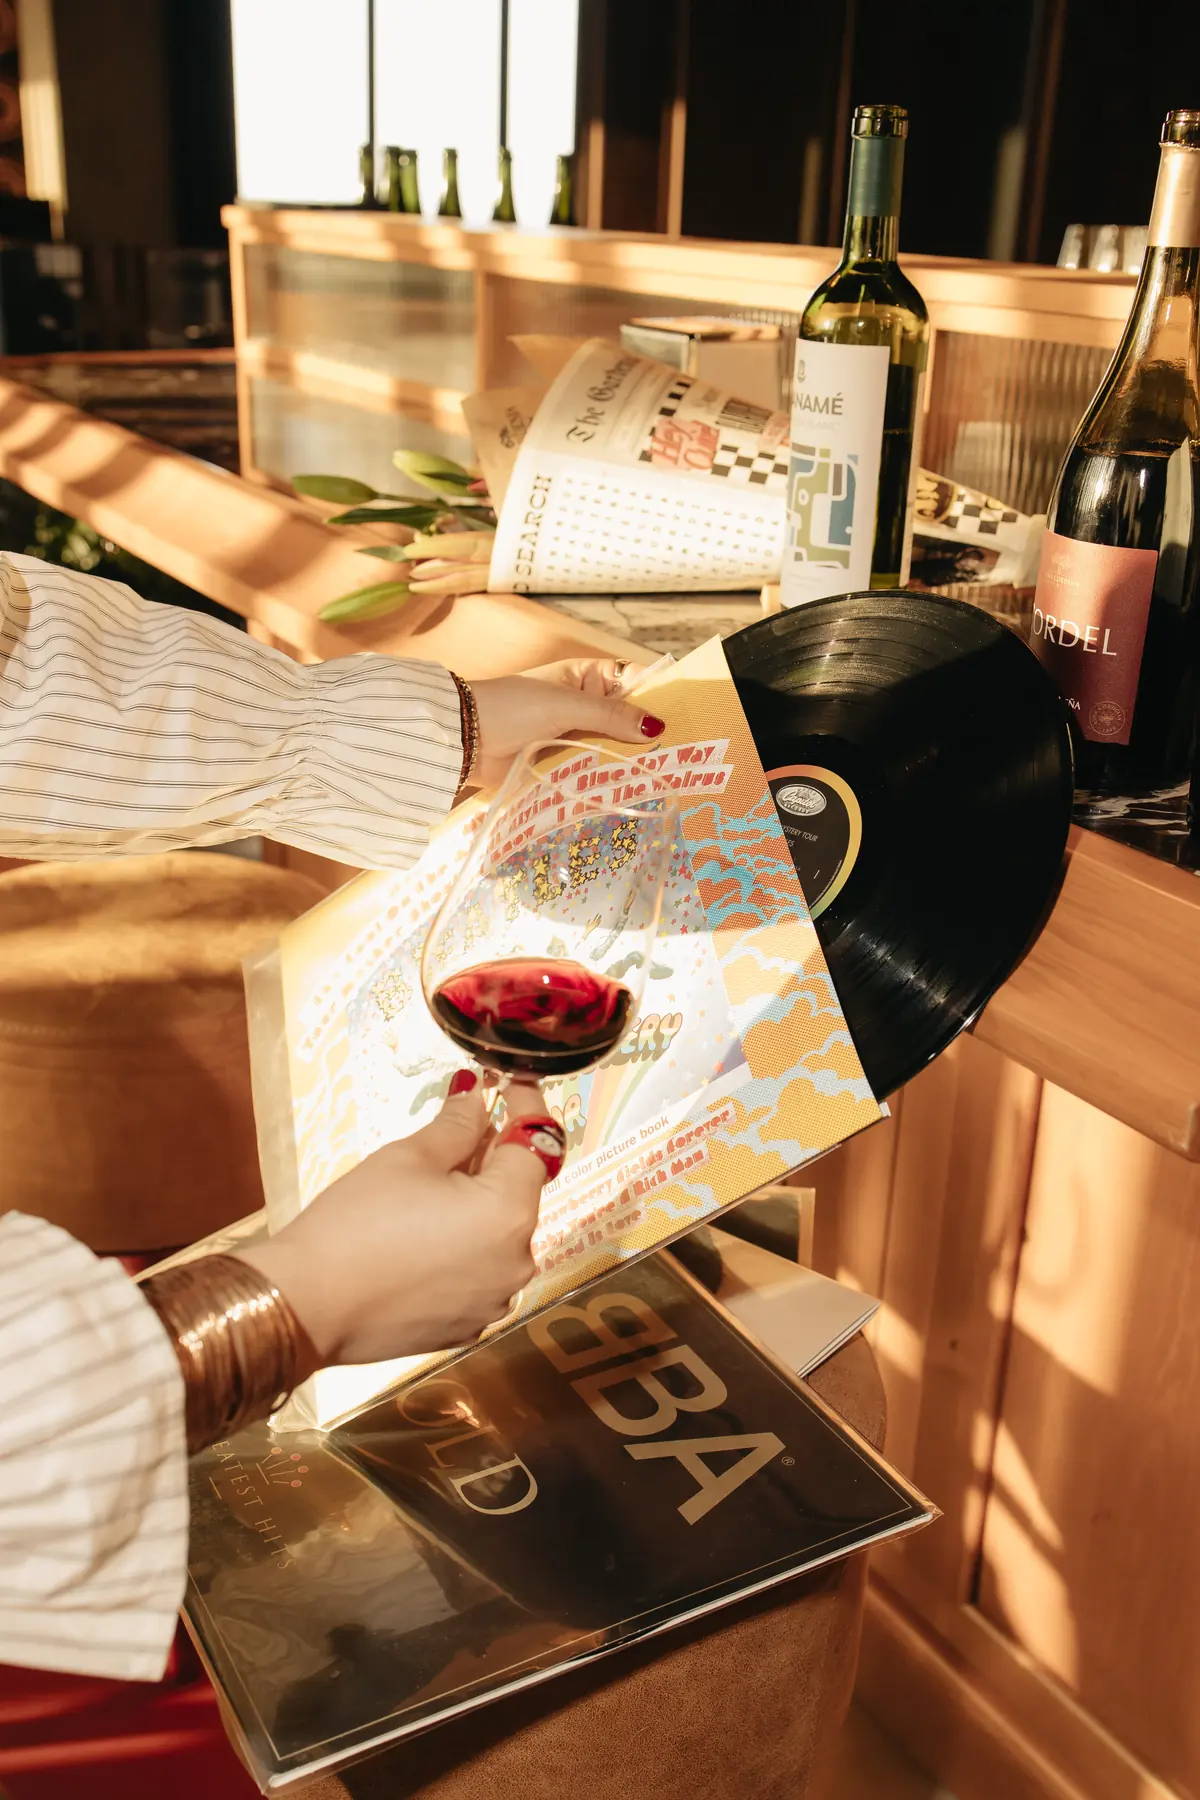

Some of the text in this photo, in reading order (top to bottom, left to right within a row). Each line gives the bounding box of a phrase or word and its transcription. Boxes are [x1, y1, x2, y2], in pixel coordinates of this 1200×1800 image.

[794, 392, 844, 416] NAMÉ
[515, 474, 552, 576] SEARCH
[1032, 602, 1117, 656] ORDEL
[577, 768, 625, 791] Blue
[677, 746, 716, 764] Way
[612, 784, 646, 804] The
[652, 770, 726, 792] Walrus
[782, 823, 819, 842] YSTERY TOUR
[564, 1162, 593, 1184] color
[595, 1135, 637, 1169] picture
[639, 1115, 670, 1140] book
[632, 1169, 668, 1197] Rich
[670, 1149, 705, 1177] Man
[537, 1178, 613, 1229] rawberry
[544, 1238, 585, 1270] Need
[605, 1209, 642, 1236] Love
[526, 1291, 787, 1526] BBA
[397, 1377, 539, 1516] OLD
[212, 1440, 297, 1570] EATEST HITS
